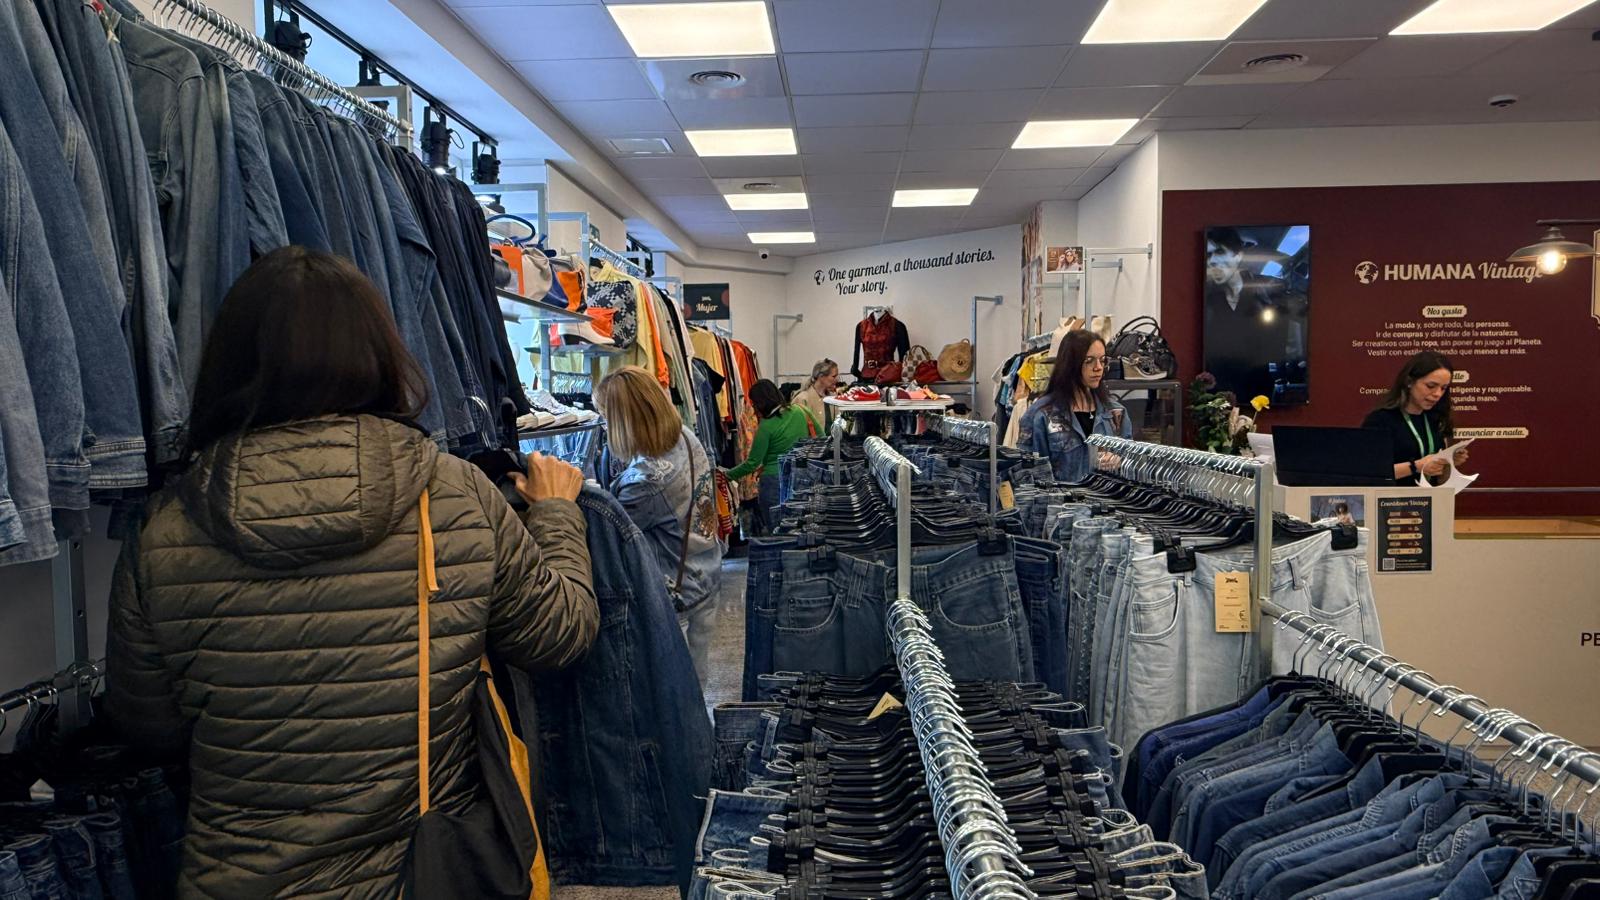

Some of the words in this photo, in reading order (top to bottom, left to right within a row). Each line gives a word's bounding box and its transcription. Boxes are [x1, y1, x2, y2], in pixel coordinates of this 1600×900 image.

[828, 268, 846, 281] One
[848, 262, 893, 282] garment,
[894, 262, 901, 273] a
[903, 252, 953, 271] thousand
[955, 248, 995, 264] stories.
[1384, 263, 1476, 281] HUMANA
[835, 282, 859, 295] Your
[860, 280, 888, 294] story.
[695, 303, 718, 314] Mujer
[1427, 307, 1440, 315] Nos
[1392, 331, 1423, 339] compras
[1452, 340, 1473, 348] poner
[1484, 339, 1505, 348] juego
[1450, 386, 1480, 394] teligente
[1451, 395, 1476, 403] gunda
[1502, 428, 1525, 436] nada.
